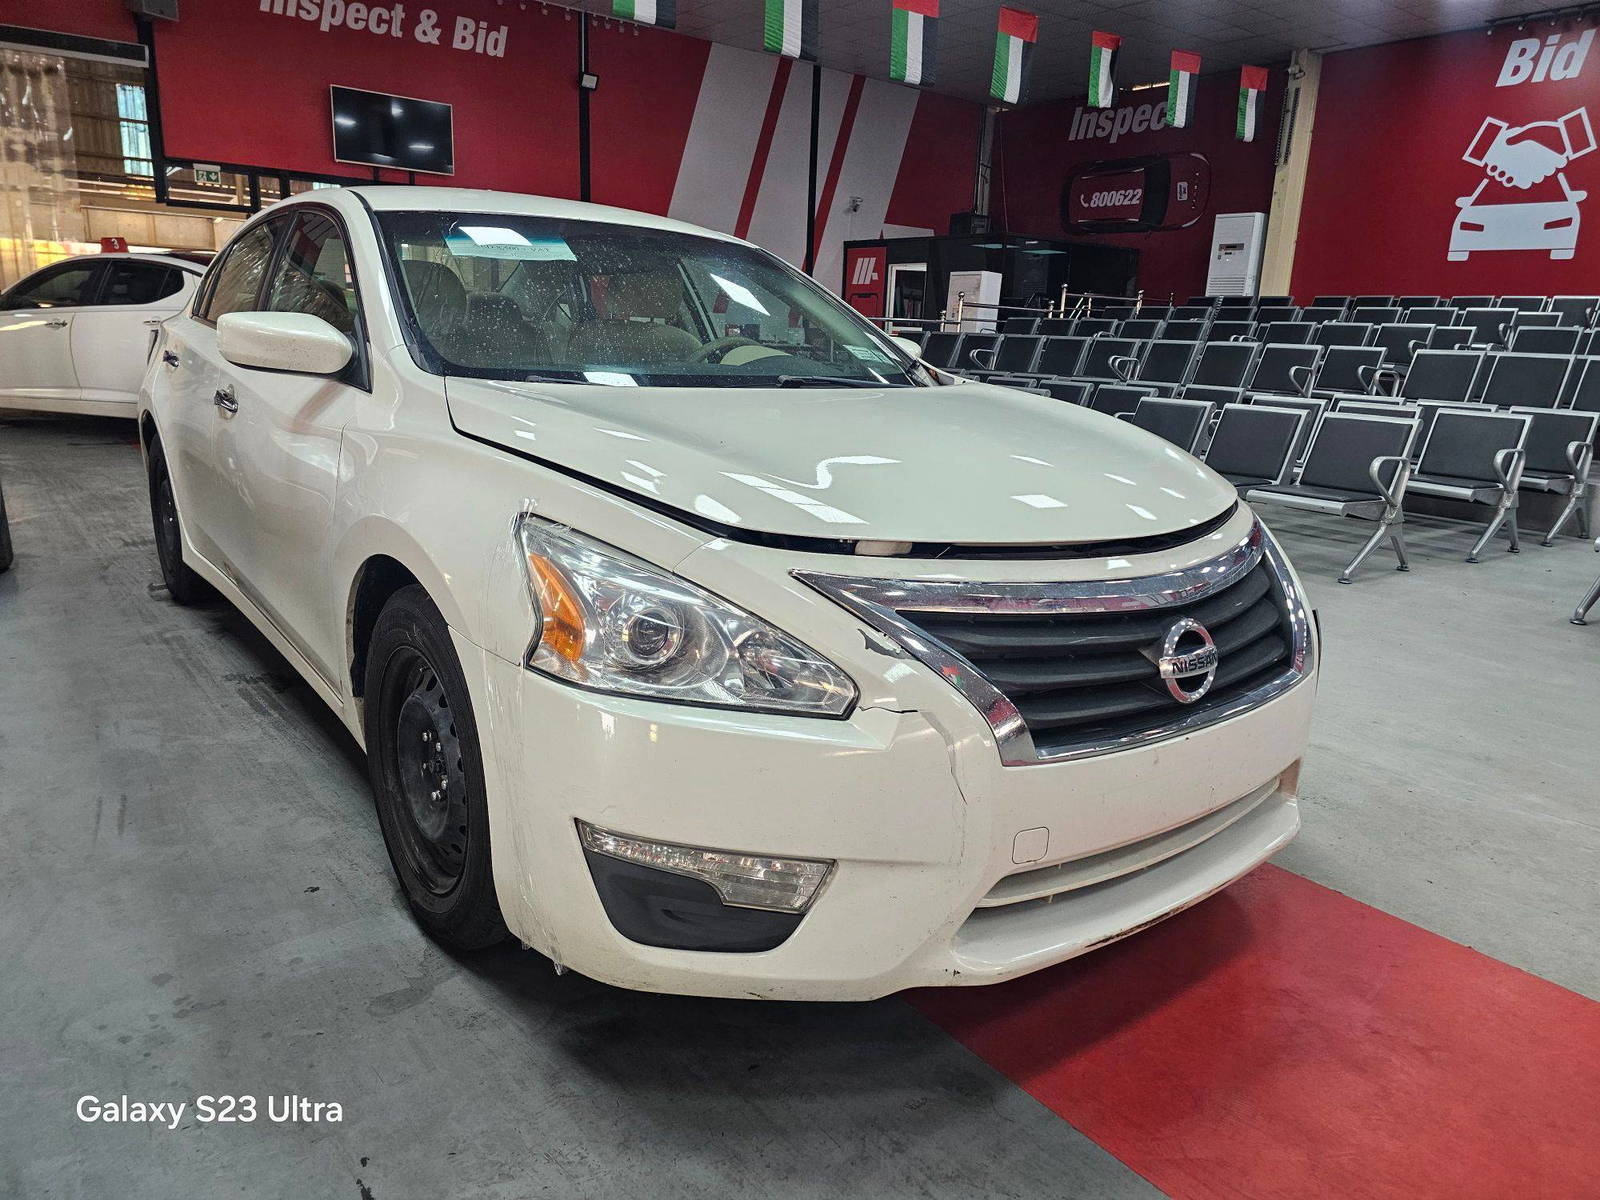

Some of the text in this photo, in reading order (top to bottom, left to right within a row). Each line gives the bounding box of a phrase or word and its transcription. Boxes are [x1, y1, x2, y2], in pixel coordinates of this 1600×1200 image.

[414, 9, 442, 45] &
[452, 15, 508, 58] Bid
[1495, 28, 1597, 88] Bid
[1068, 101, 1171, 144] Inspec
[1090, 188, 1142, 208] 800622
[111, 238, 120, 250] 3
[1172, 651, 1217, 674] NISSAN
